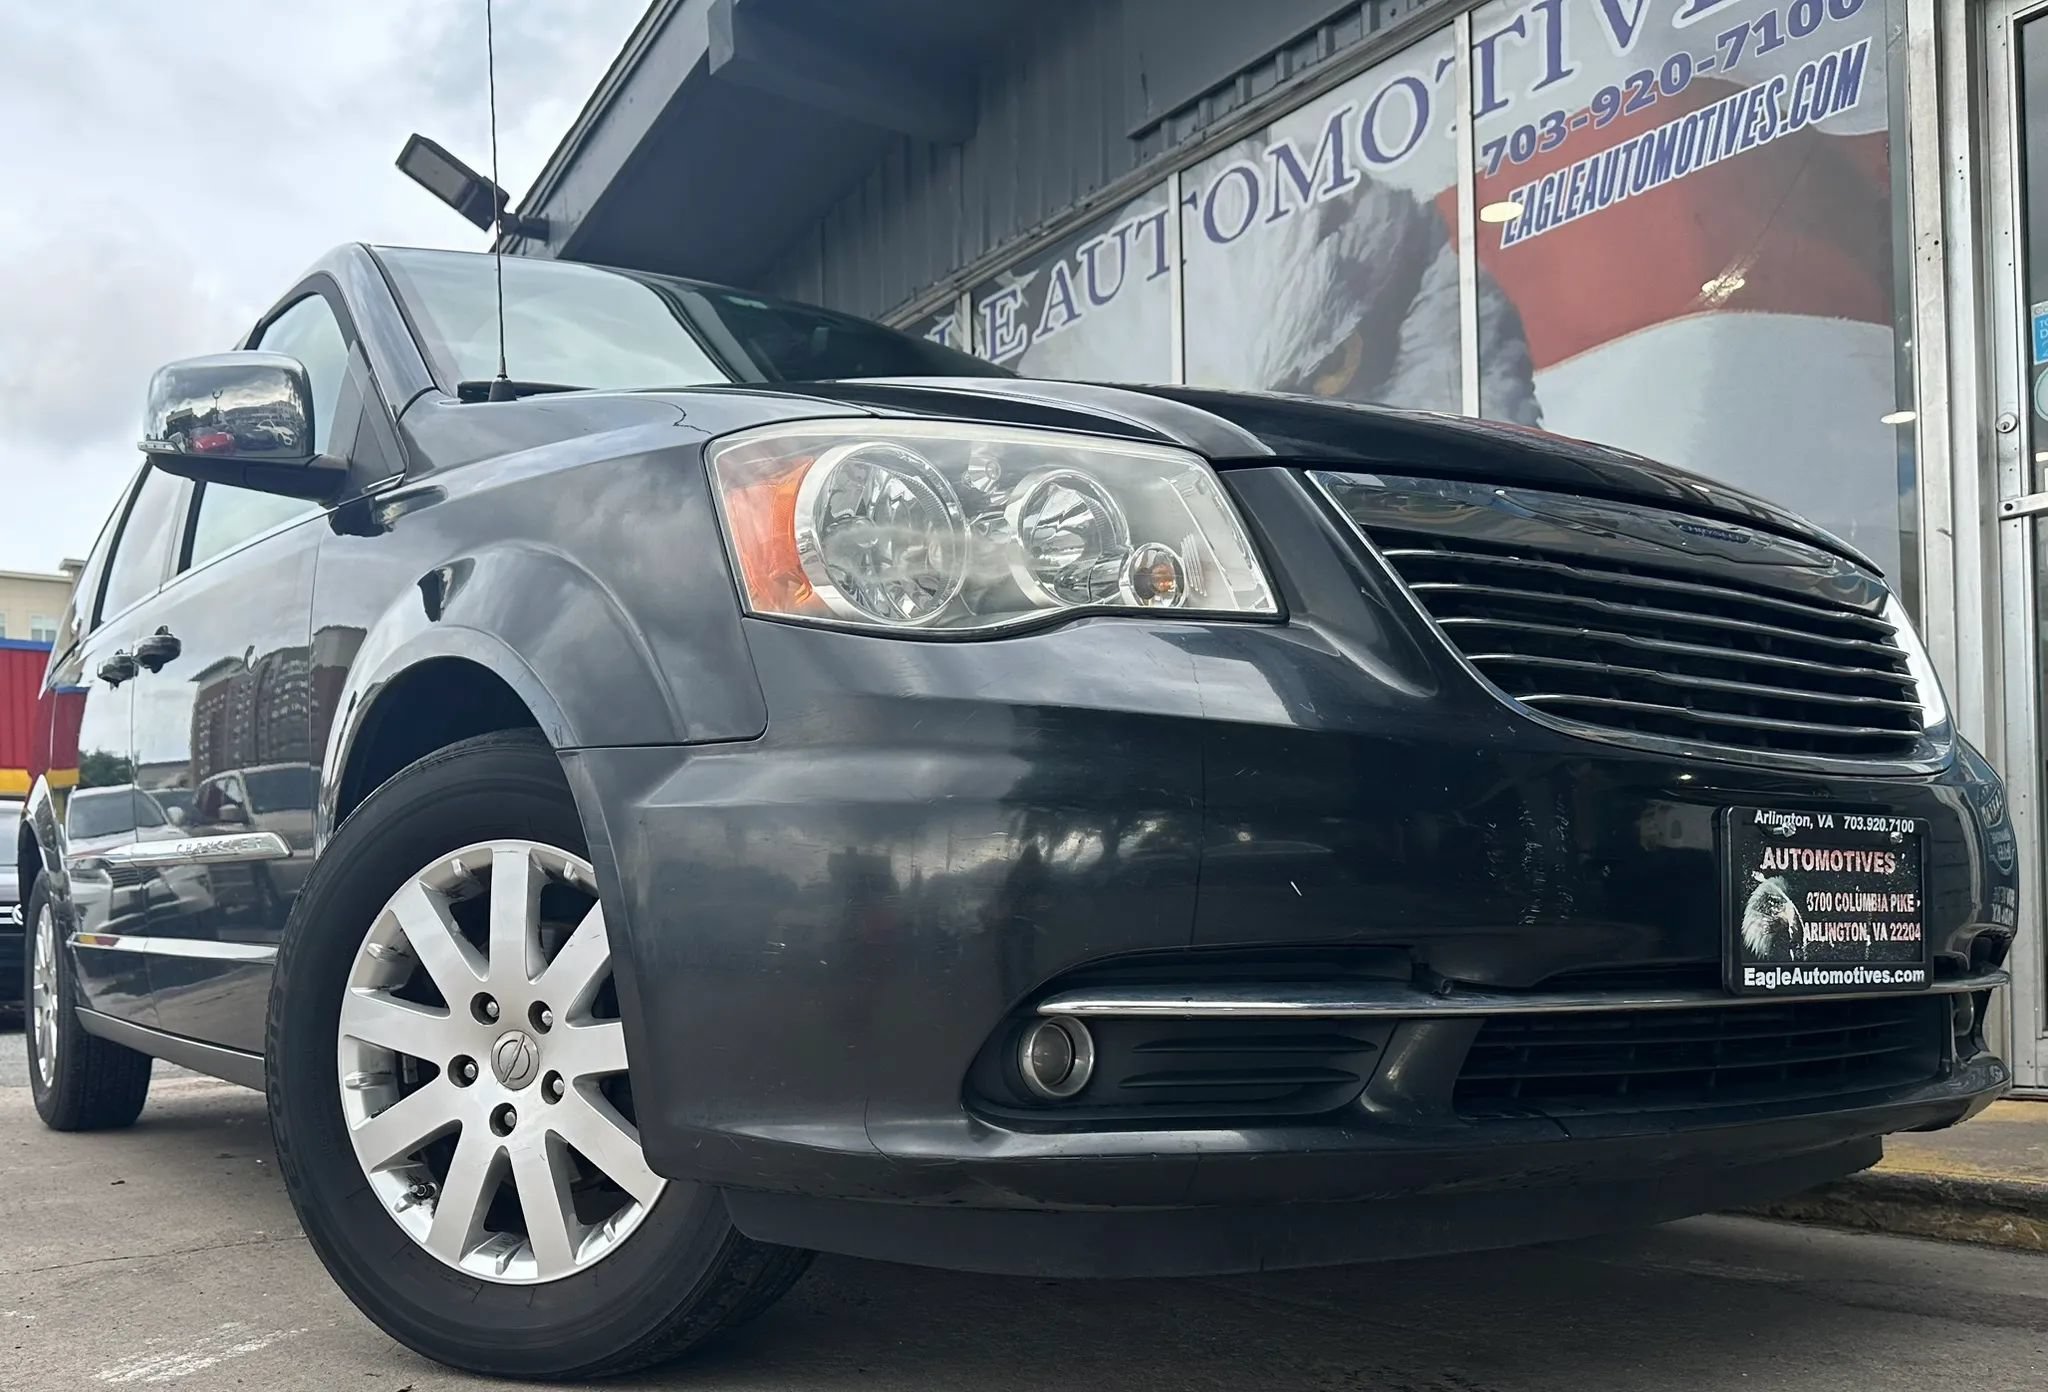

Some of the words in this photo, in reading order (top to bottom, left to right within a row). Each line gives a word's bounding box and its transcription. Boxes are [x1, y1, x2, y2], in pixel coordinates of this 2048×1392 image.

[1501, 37, 1871, 249] EAGLEAUTOMOTIVES.COM
[1033, 0, 1742, 343] AUTOMOTIV
[1754, 809, 1814, 830] Arlington,
[1817, 814, 1834, 829] VA
[1844, 816, 1915, 833] 703.920.7100
[1761, 846, 1896, 874] AUTOMOTIVES
[1835, 892, 1888, 912] COLUMBIA
[1890, 893, 1915, 912] PIKE
[1873, 922, 1888, 941] VA
[1890, 922, 1921, 941] 22204
[1743, 966, 1925, 989] EagleAutomotives.com
